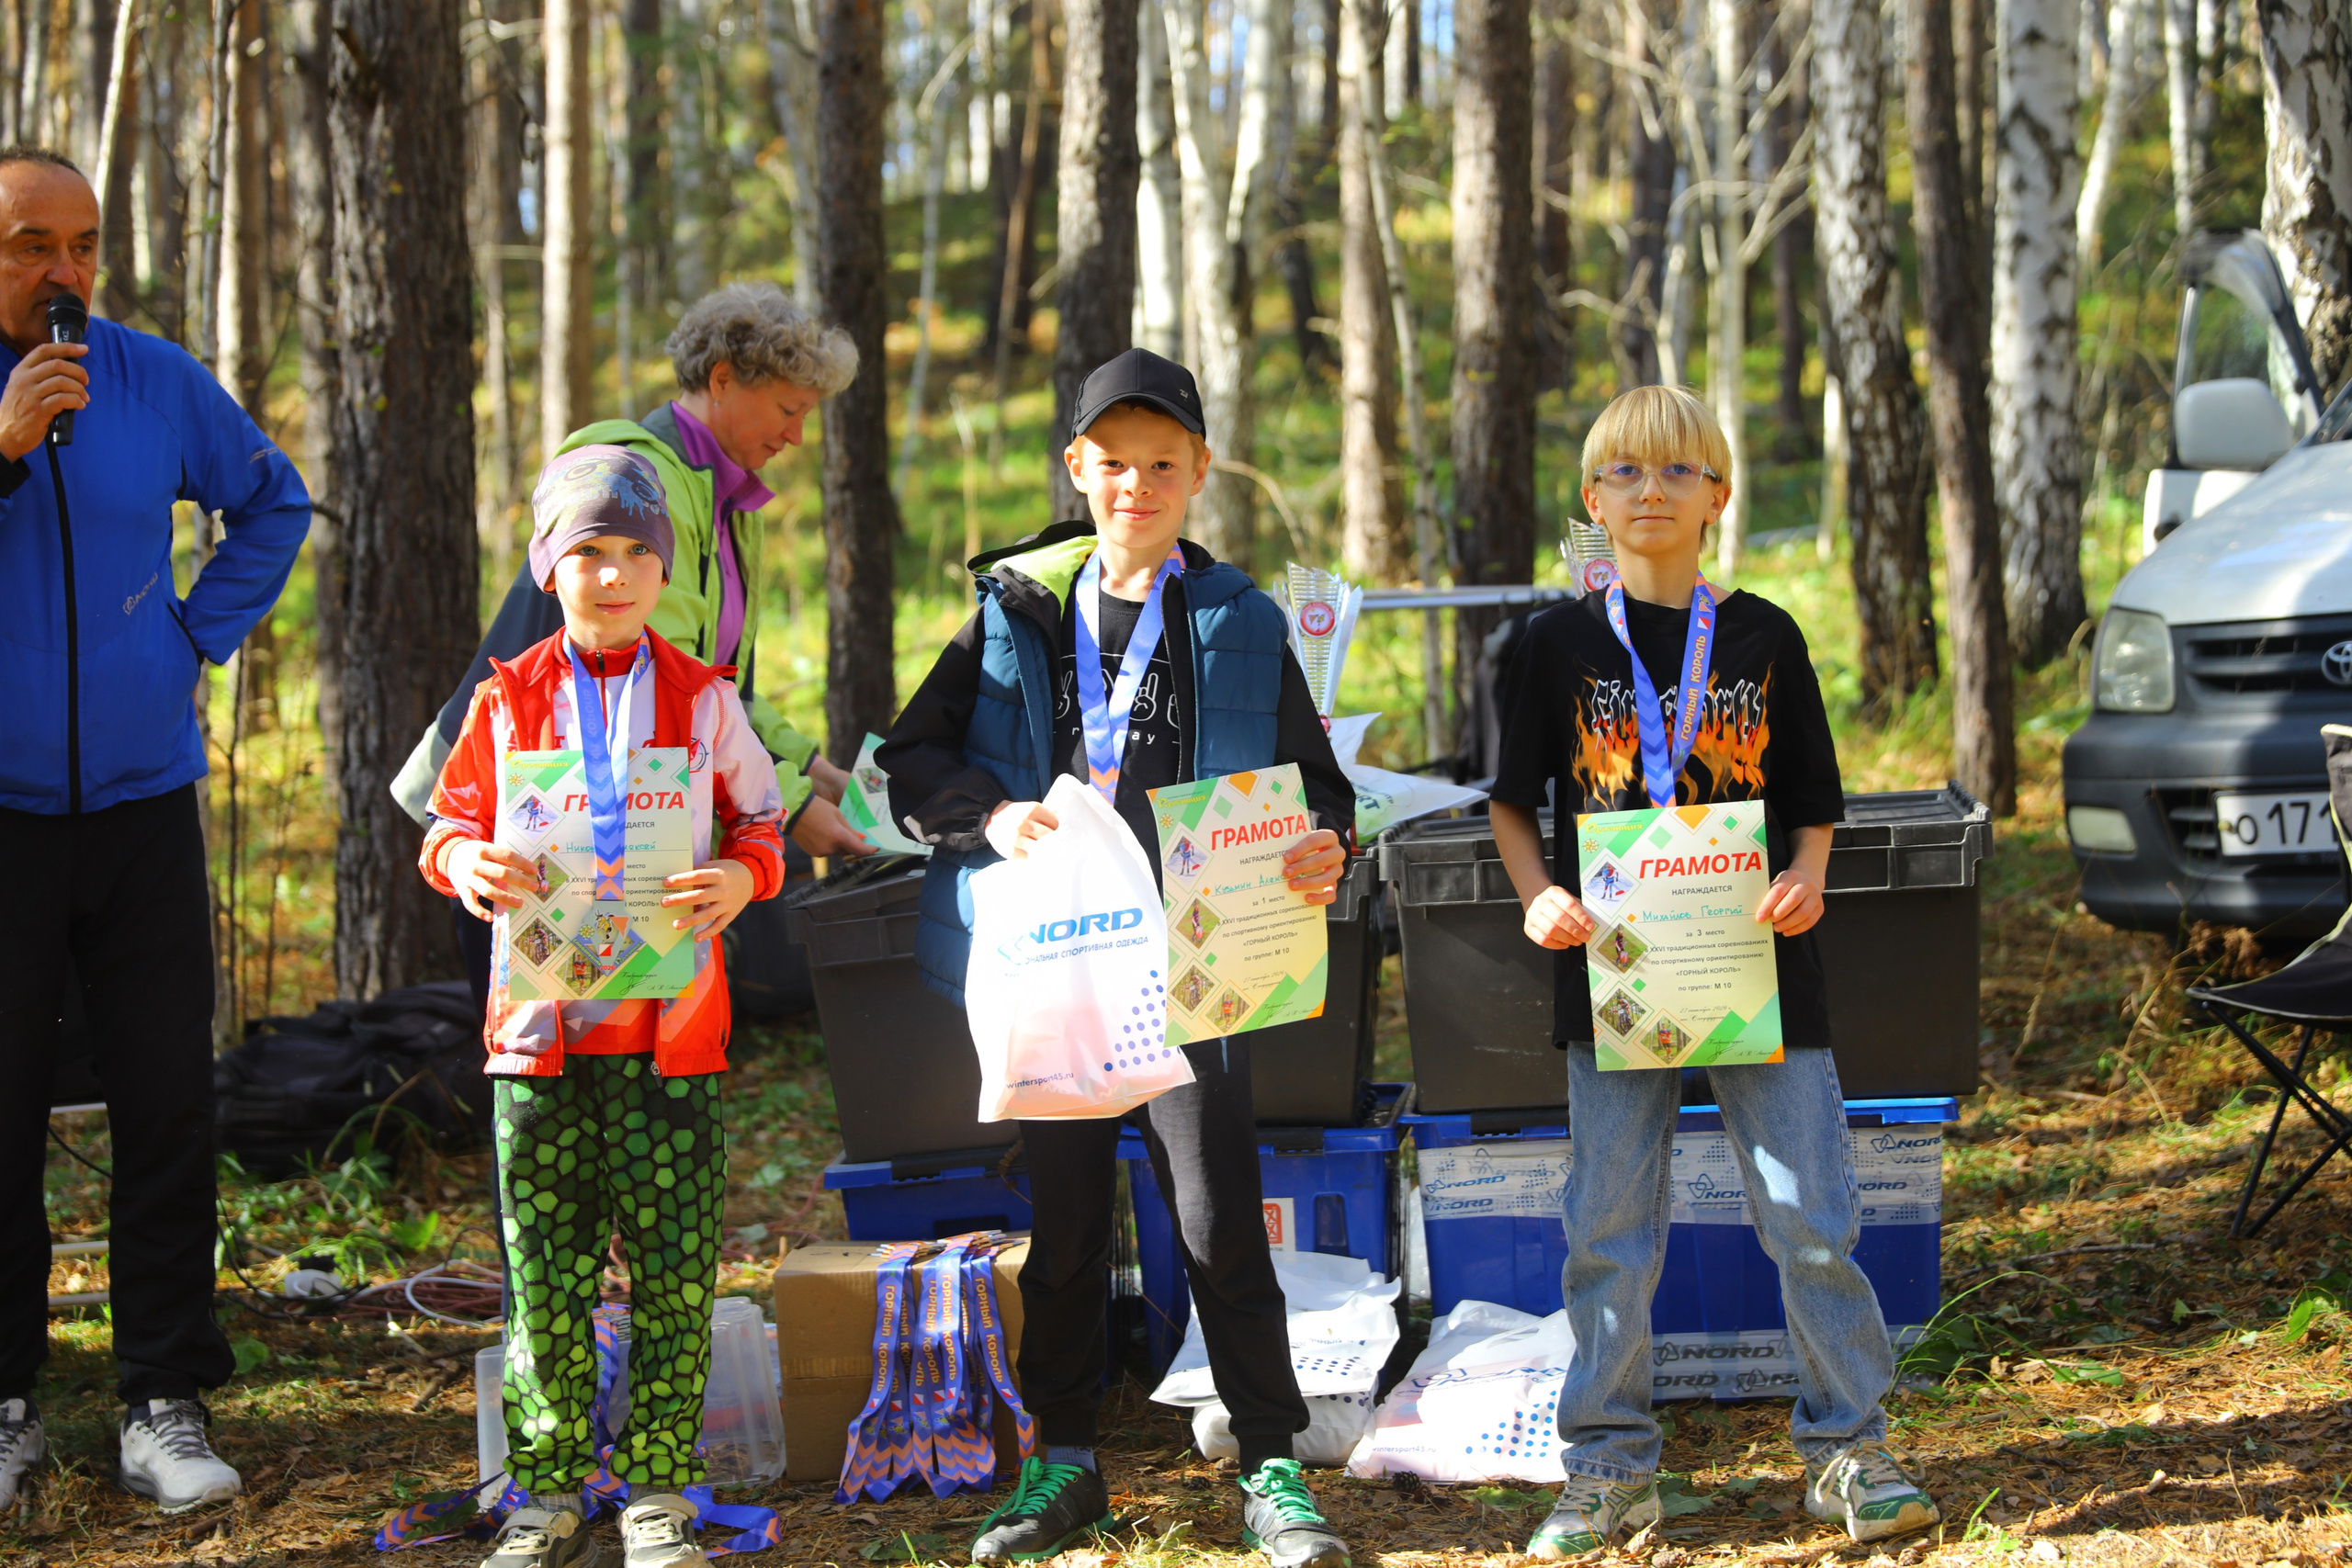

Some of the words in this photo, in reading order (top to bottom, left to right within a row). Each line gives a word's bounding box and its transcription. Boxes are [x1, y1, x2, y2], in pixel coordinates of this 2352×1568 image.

[1680, 687, 1700, 740] ГОРНЫЙ
[1690, 635, 1706, 683] КОРОЛЬ
[563, 791, 684, 812] ГРОТА
[1211, 814, 1307, 851] ГРАМОТА
[1239, 850, 1288, 865] НАГРАЖДАЕТС
[1639, 852, 1762, 879] ГРАМОТА
[626, 887, 683, 896] ориентированию
[1671, 885, 1733, 896] НАГРАЖДАЕТСЯ
[1236, 910, 1278, 922] традиционных
[1701, 904, 1743, 917] Георгий
[1231, 925, 1268, 937] спортивному
[1269, 915, 1317, 930] ориентированию
[1061, 941, 1113, 958] СПОРТИВНАЯ
[1115, 936, 1148, 948] ОДЕЖДА
[1667, 942, 1716, 952] традиционных
[1717, 939, 1768, 949] соревнованиях
[1661, 956, 1704, 965] спортивному
[1705, 953, 1764, 963] ориентированию
[1676, 967, 1708, 976] «ГОРНЫЙ
[1710, 966, 1741, 975] КОРОЛЬ»
[1688, 985, 1713, 993] группе:
[1006, 1072, 1074, 1089] wintersport45.ru
[1896, 1136, 1941, 1149] NOR
[1446, 1175, 1506, 1189] NORD
[1858, 1181, 1907, 1190] ORD
[1705, 1190, 1747, 1199] NOR
[1435, 1198, 1493, 1211] NORD
[942, 1274, 953, 1325] ГОРНЫЙ
[881, 1284, 896, 1337] ГОРНЫЙ
[975, 1278, 994, 1329] ГОРНЫЙ
[987, 1334, 1003, 1382] КОРОЛЬ
[943, 1330, 957, 1381] КОРОЛЬ
[1681, 1346, 1774, 1359] NORD
[876, 1342, 888, 1392] КОРОЛЬ
[923, 1337, 941, 1383] КОРОЛЬ
[1654, 1375, 1719, 1386] ORD
